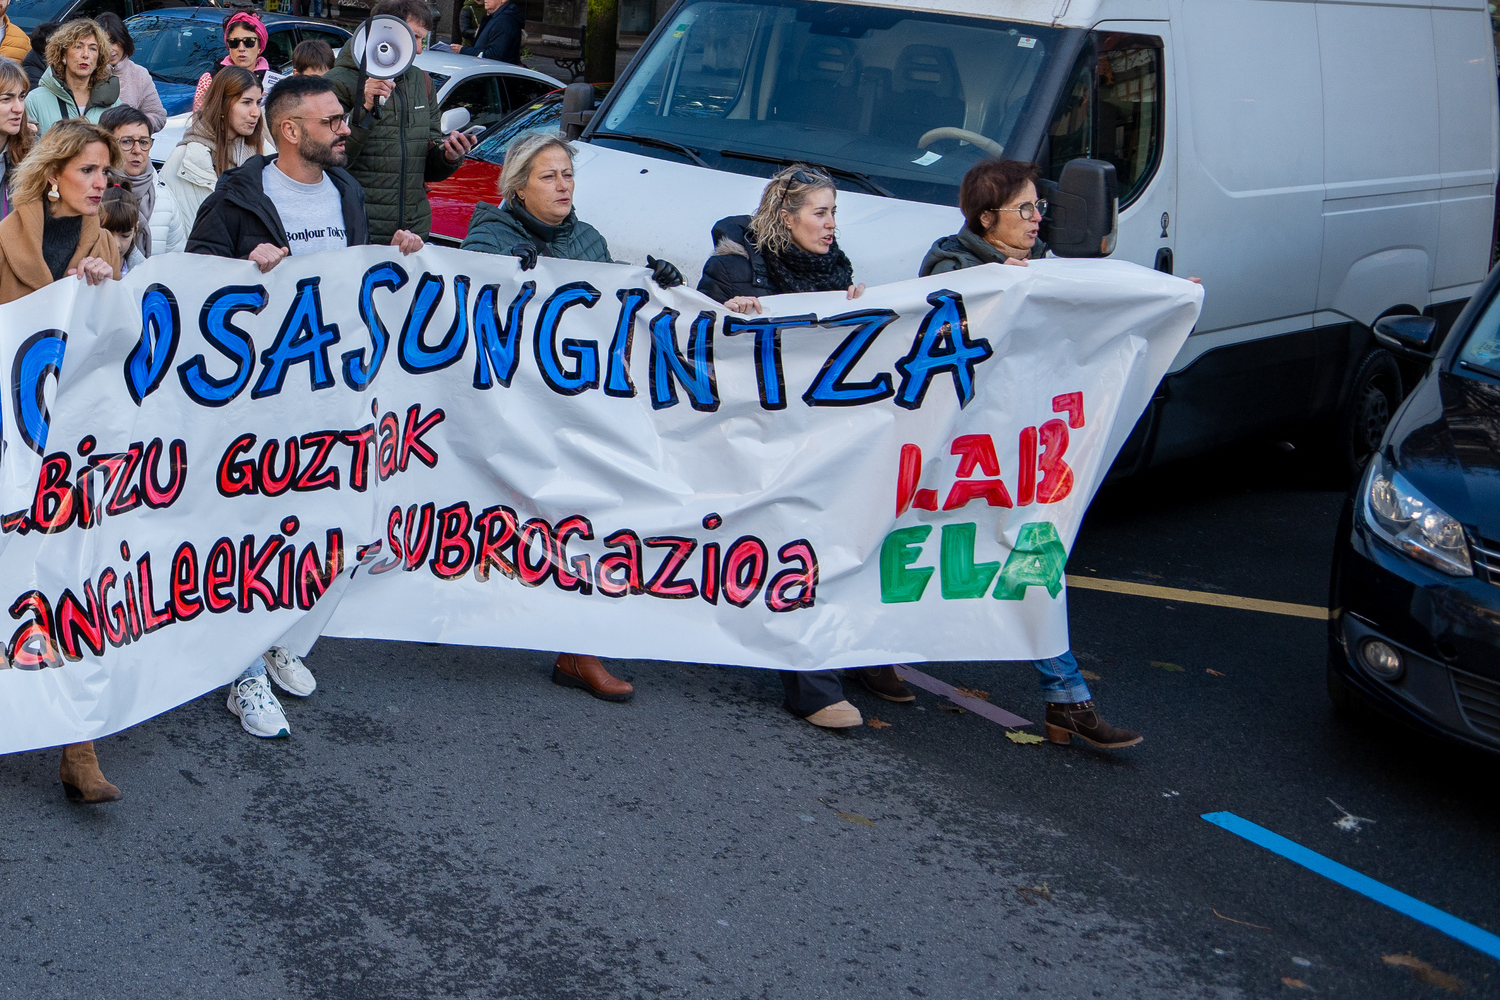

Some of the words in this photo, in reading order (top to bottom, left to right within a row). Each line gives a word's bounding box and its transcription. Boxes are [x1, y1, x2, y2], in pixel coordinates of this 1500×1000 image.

[285, 228, 326, 242] Bonjour
[124, 260, 994, 412] OSASUNGINTZA
[896, 418, 1075, 519] LAB
[879, 521, 1068, 604] ELA
